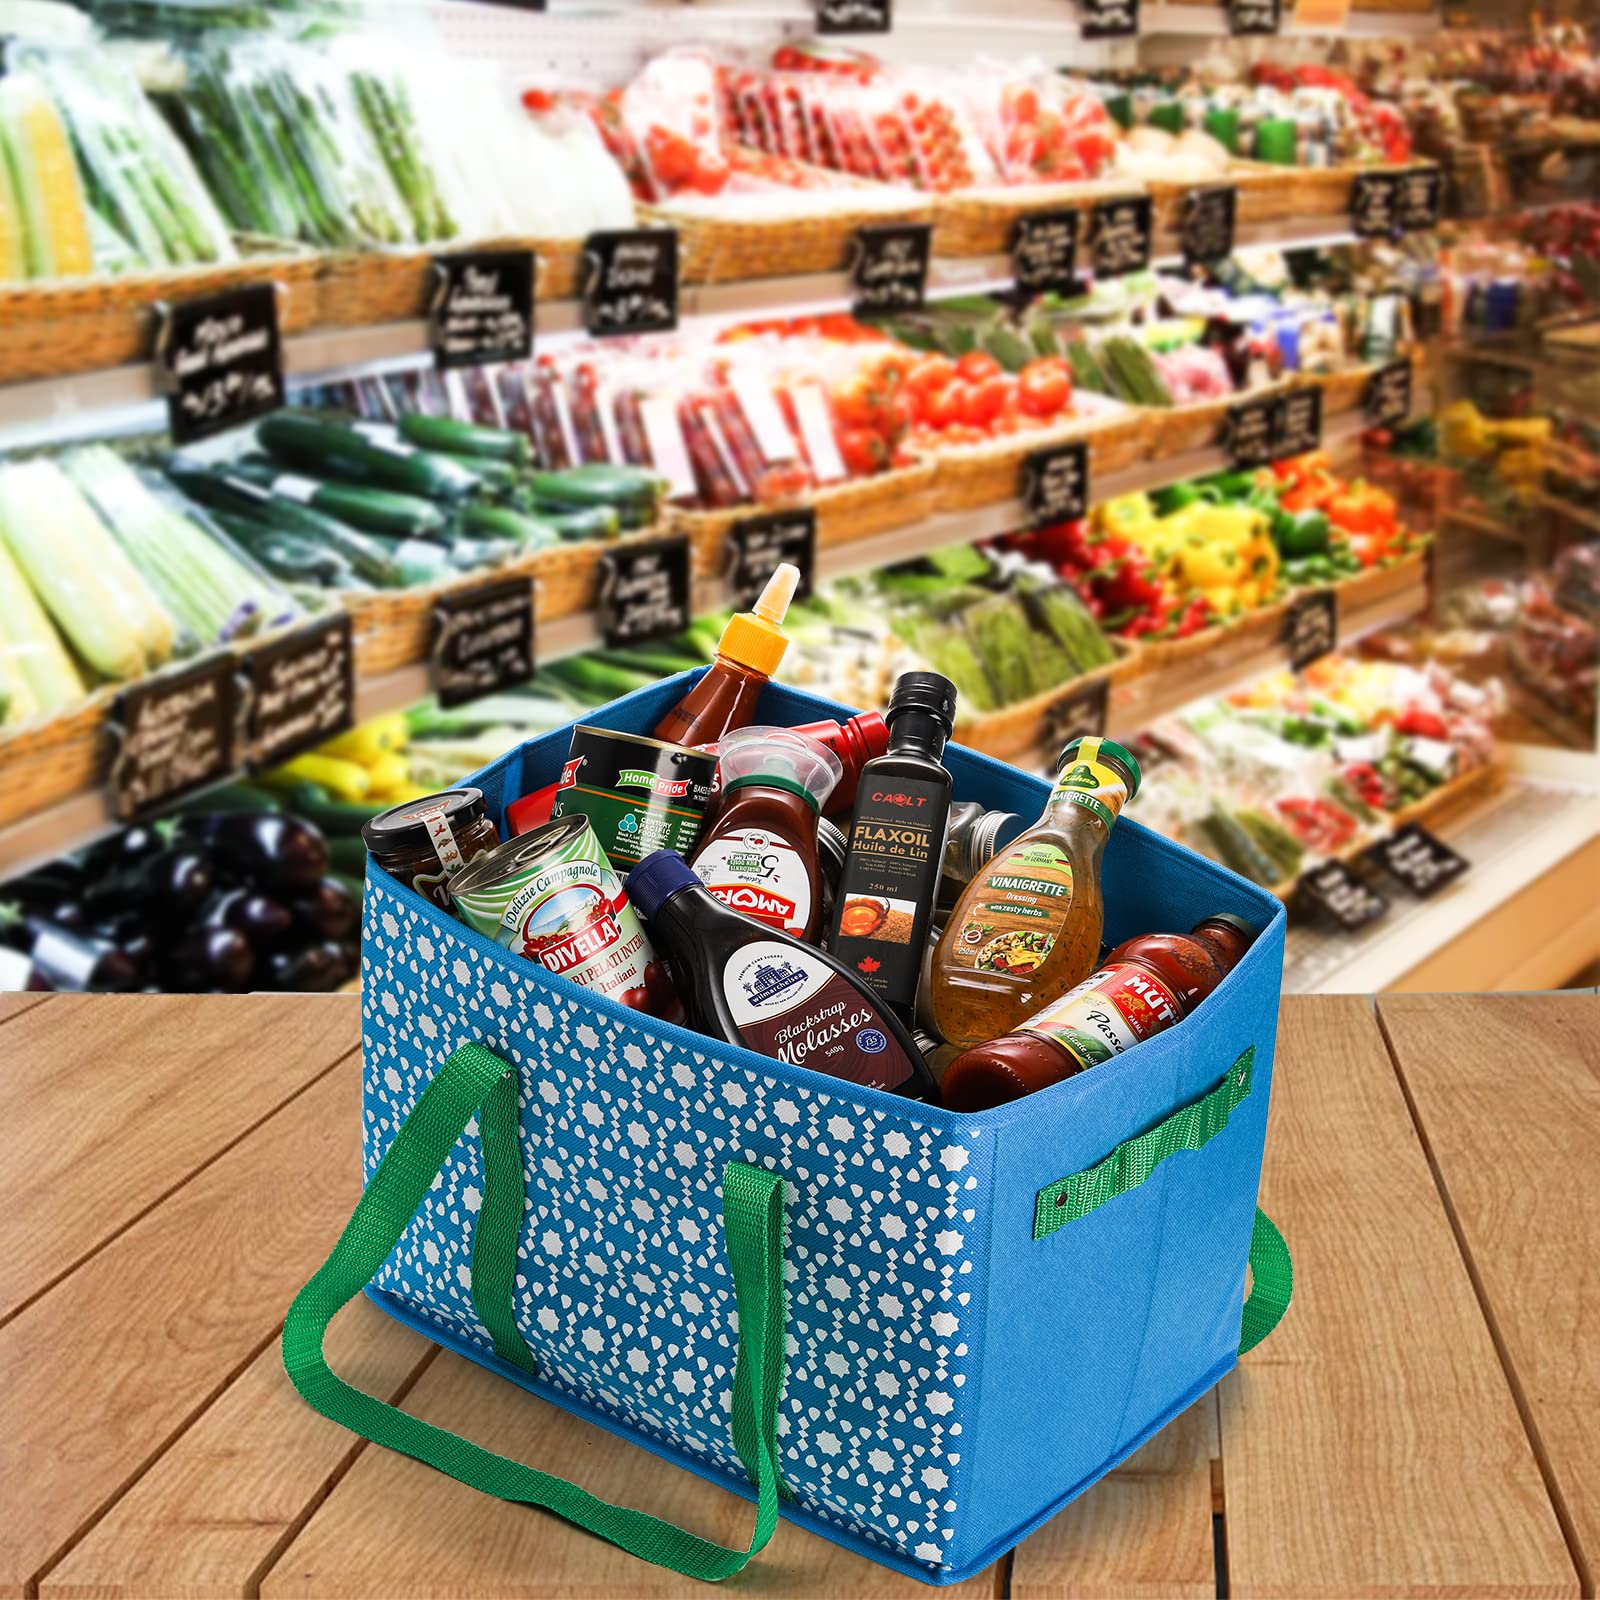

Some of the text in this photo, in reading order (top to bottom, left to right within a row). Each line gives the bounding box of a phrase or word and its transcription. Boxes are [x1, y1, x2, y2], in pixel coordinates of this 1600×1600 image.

[624, 772, 683, 794] Home Pride
[639, 823, 671, 836] PACIFIC
[641, 816, 672, 830] CENTURY
[854, 826, 930, 848] FLAXOIL
[852, 840, 928, 858] Huile de Lin
[756, 854, 780, 878] 5
[506, 864, 598, 924] Delizie Campagnole
[869, 882, 884, 890] 250
[990, 876, 1066, 897] VINAIGRETTE
[1006, 892, 1038, 905] Dressing
[1002, 905, 1022, 915] zesty
[1022, 906, 1042, 917] herbs
[544, 918, 618, 972] DIVELLA
[568, 972, 588, 986] RI
[586, 950, 623, 982] PELATI
[600, 963, 637, 994] Italiani
[1124, 975, 1178, 1026] MUT
[774, 1001, 847, 1046] Blackstrap
[1128, 1014, 1143, 1034] PARMA
[776, 1008, 873, 1065] Molasses
[1056, 1027, 1087, 1053] Delicate
[825, 1044, 845, 1058] 540g
